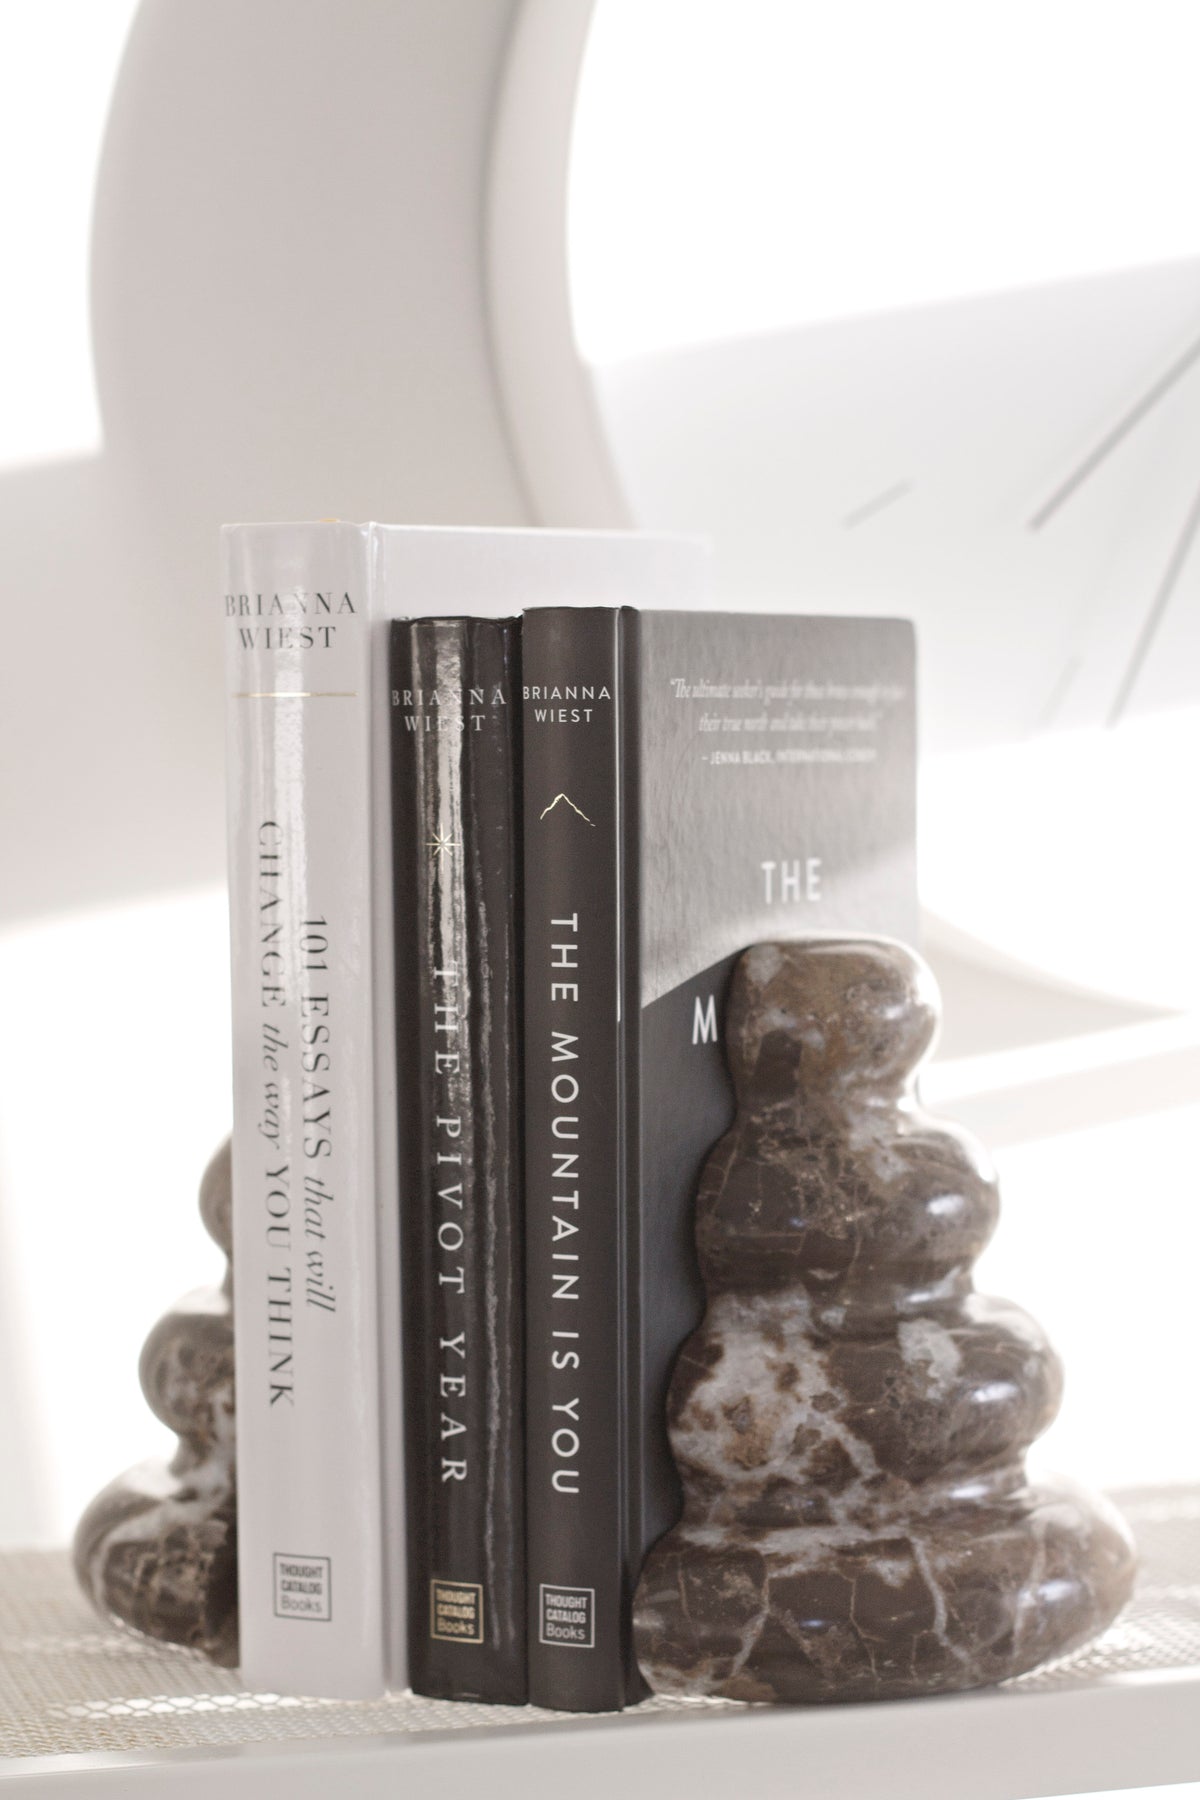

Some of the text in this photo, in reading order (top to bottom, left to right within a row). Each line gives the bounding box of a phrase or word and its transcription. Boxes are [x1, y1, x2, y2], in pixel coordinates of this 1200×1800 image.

[224, 591, 357, 616] BRIANNA
[238, 626, 337, 650] WIEST
[391, 688, 507, 706] BRIANNA
[523, 685, 612, 701] BRIANNA
[404, 715, 486, 732] WIEST
[534, 708, 594, 724] WIEST
[760, 857, 823, 905] THE
[257, 821, 295, 1407] CHANGE the way YOU THINK
[300, 915, 337, 1313] 101 ESSAYS that will
[550, 912, 580, 1494] THE MOUNTAIN IS YOU
[433, 959, 468, 1482] THE PIVOT YEAR
[279, 1562, 323, 1579] THOUGHT
[281, 1579, 323, 1596] CATALOG
[436, 1588, 476, 1605] THOUGHT
[281, 1595, 323, 1613] Books
[544, 1593, 588, 1609] THOUGHT
[437, 1603, 476, 1620] CATALOG
[545, 1608, 587, 1624] CATALOG
[437, 1617, 476, 1636] Books
[545, 1622, 586, 1640] Books
